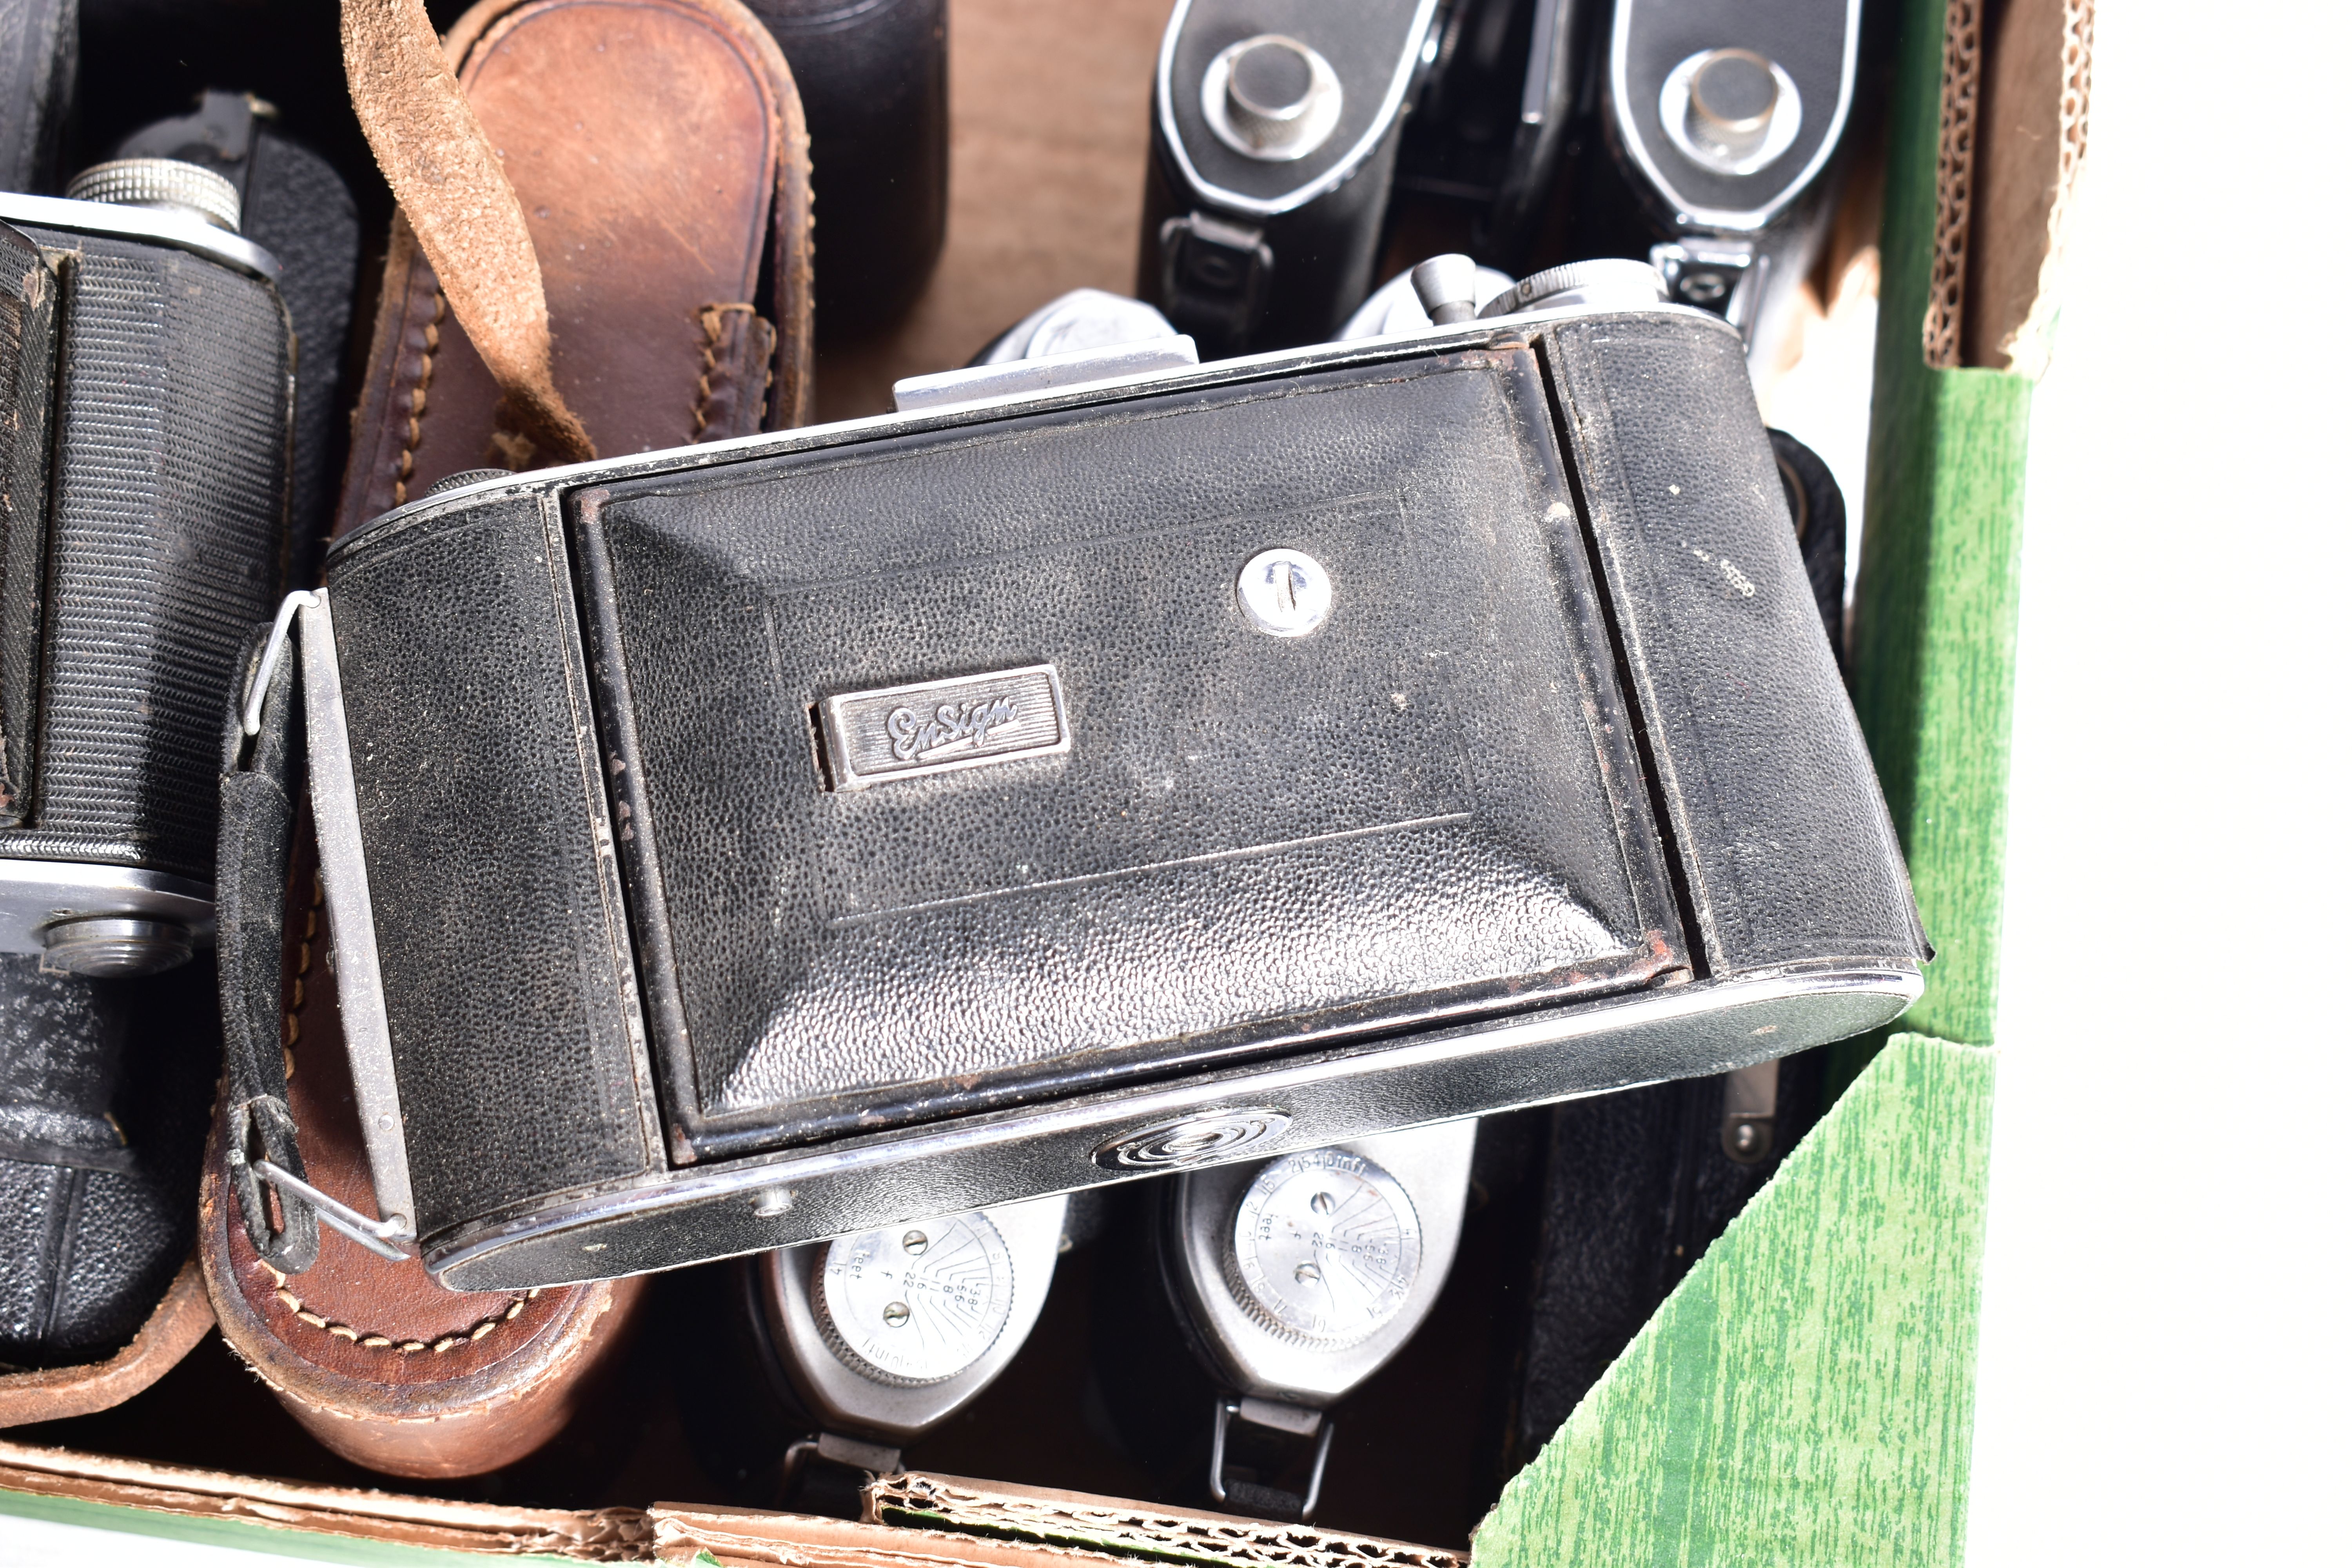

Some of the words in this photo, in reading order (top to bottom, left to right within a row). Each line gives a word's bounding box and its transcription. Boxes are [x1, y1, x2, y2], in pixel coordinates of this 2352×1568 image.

[1259, 1213, 1278, 1240] feet
[1289, 1231, 1301, 1240] f
[1312, 1232, 1324, 1248] 22
[1326, 1237, 1337, 1249] 16
[1338, 1240, 1349, 1251] 11
[1351, 1245, 1362, 1254] 8
[880, 1270, 893, 1279] f
[903, 1272, 916, 1288] 22
[917, 1276, 929, 1290] 16
[929, 1280, 941, 1292] 11
[943, 1285, 953, 1293] 8
